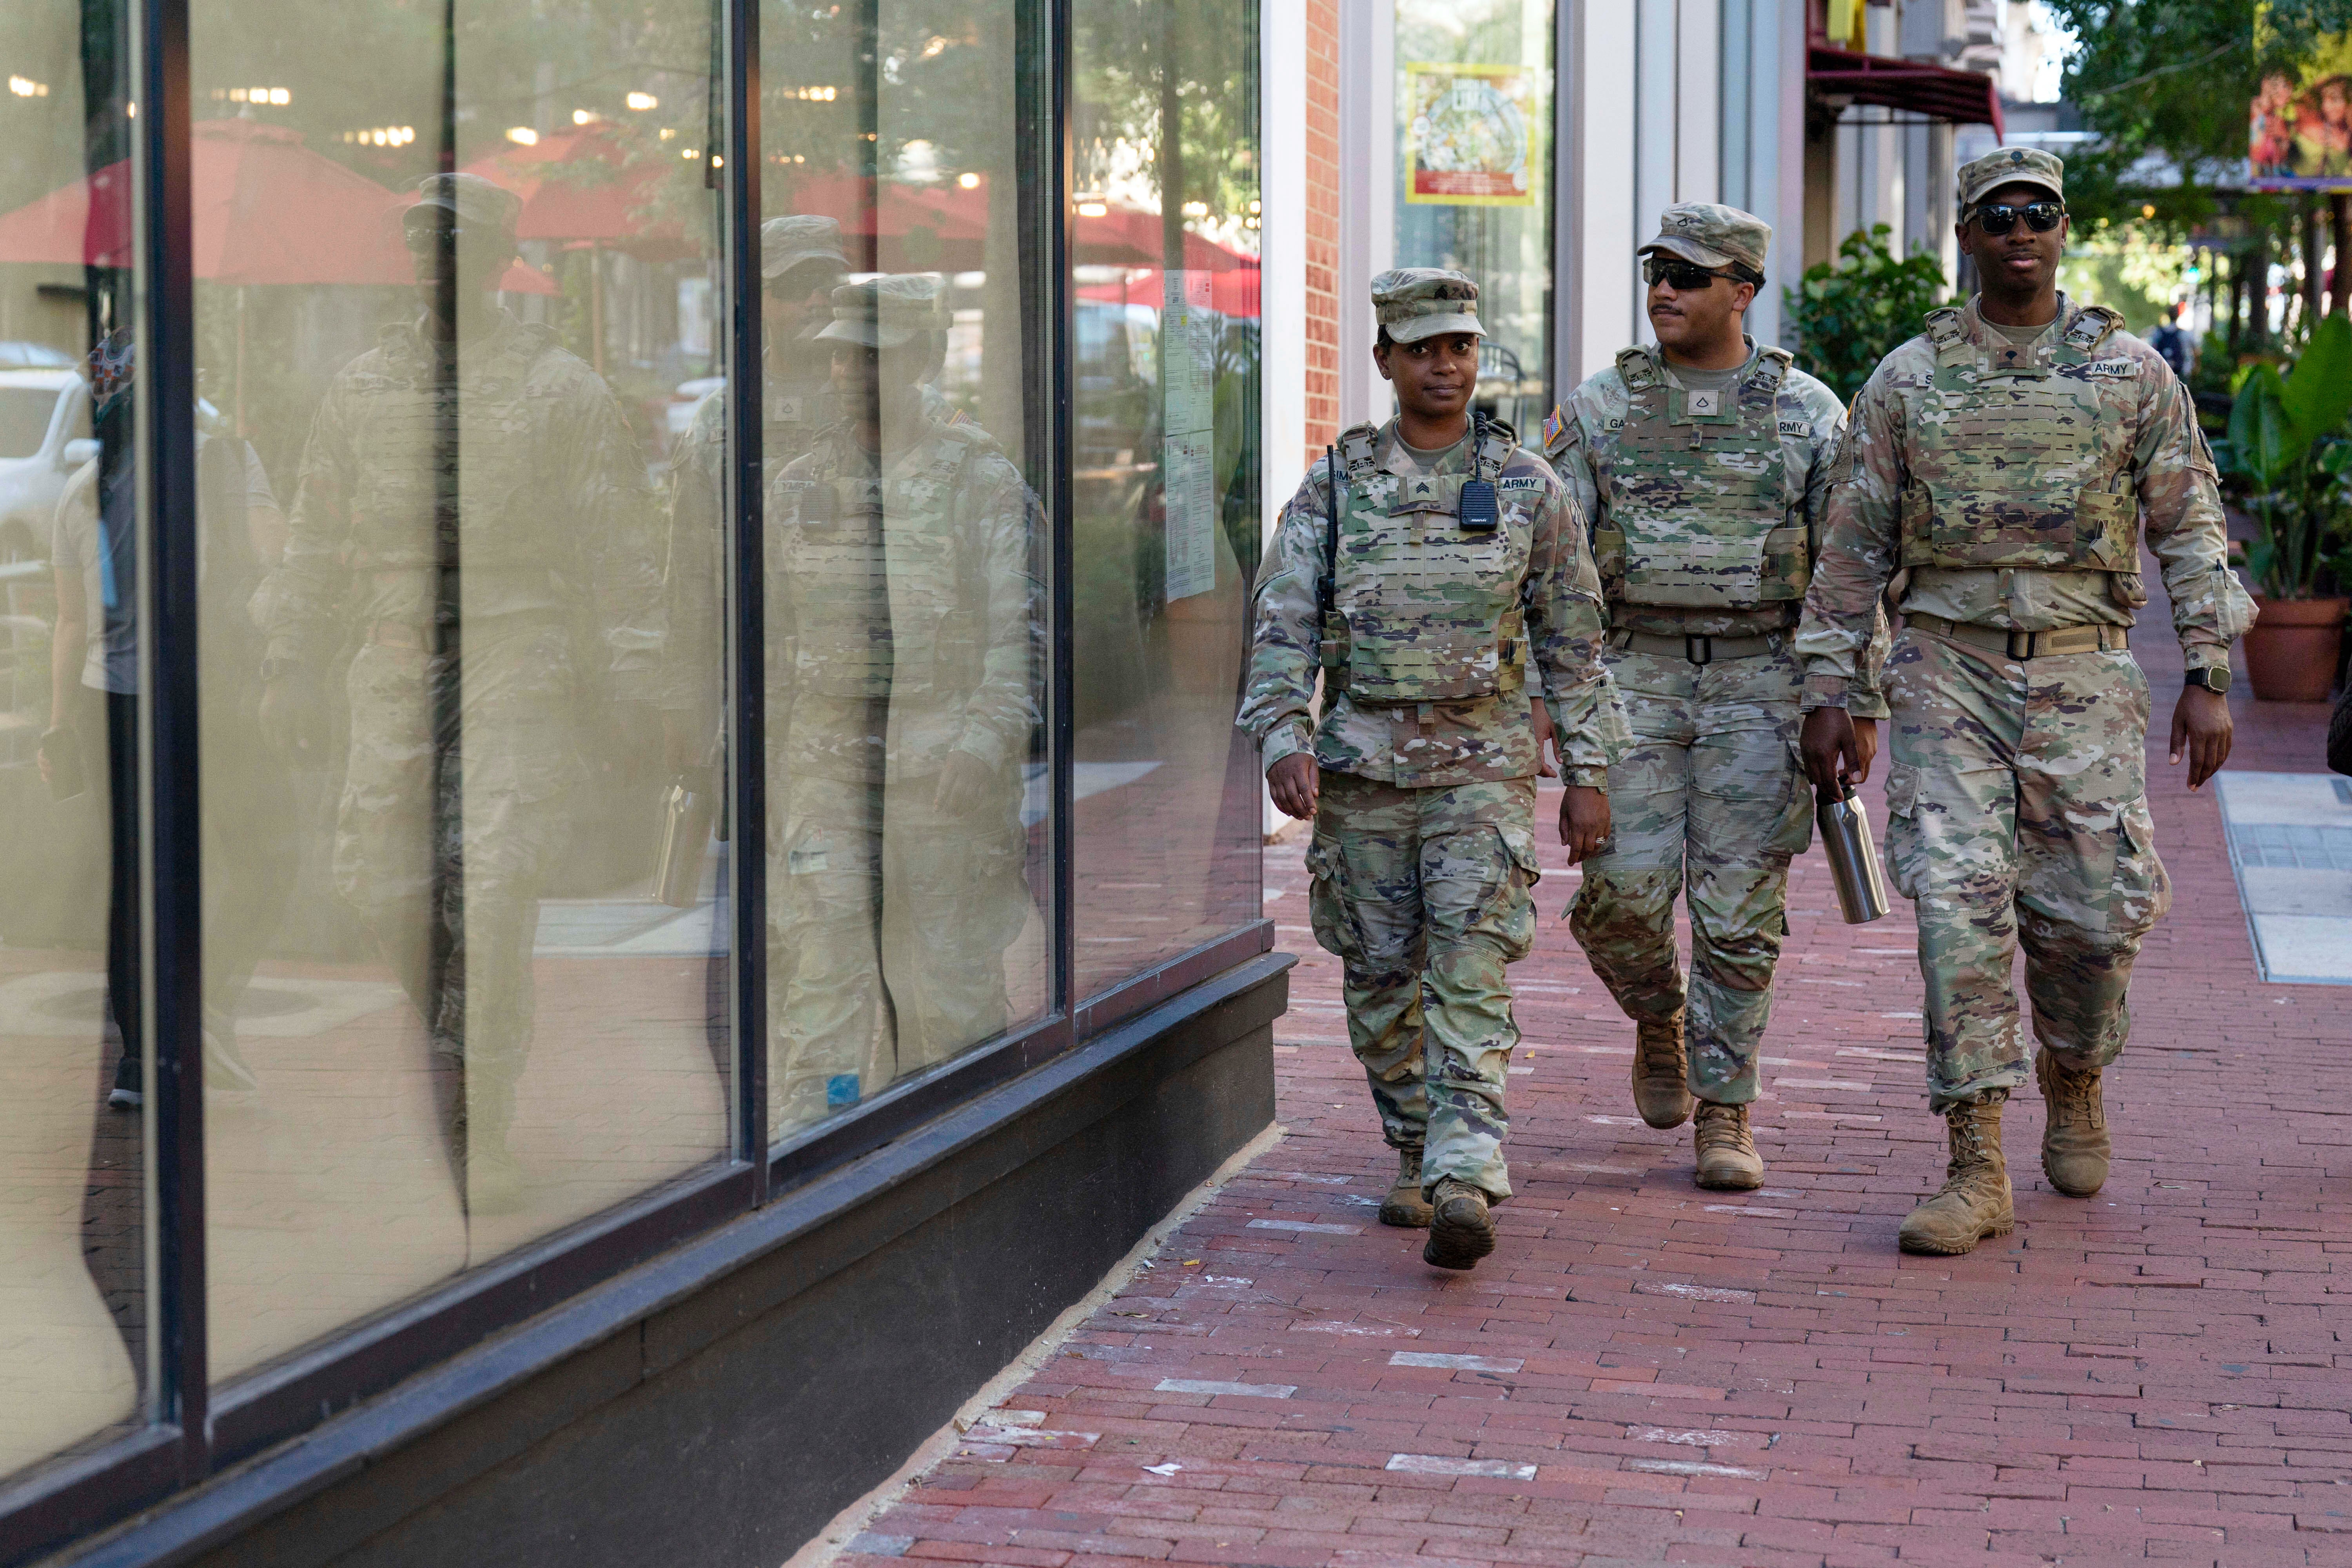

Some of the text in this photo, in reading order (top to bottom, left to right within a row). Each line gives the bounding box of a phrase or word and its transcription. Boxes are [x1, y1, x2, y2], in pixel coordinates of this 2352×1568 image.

[2095, 363, 2127, 374] ARMY
[1610, 419, 1624, 428] GA
[1779, 422, 1802, 433] RMY
[1503, 479, 1537, 489] ARMY
